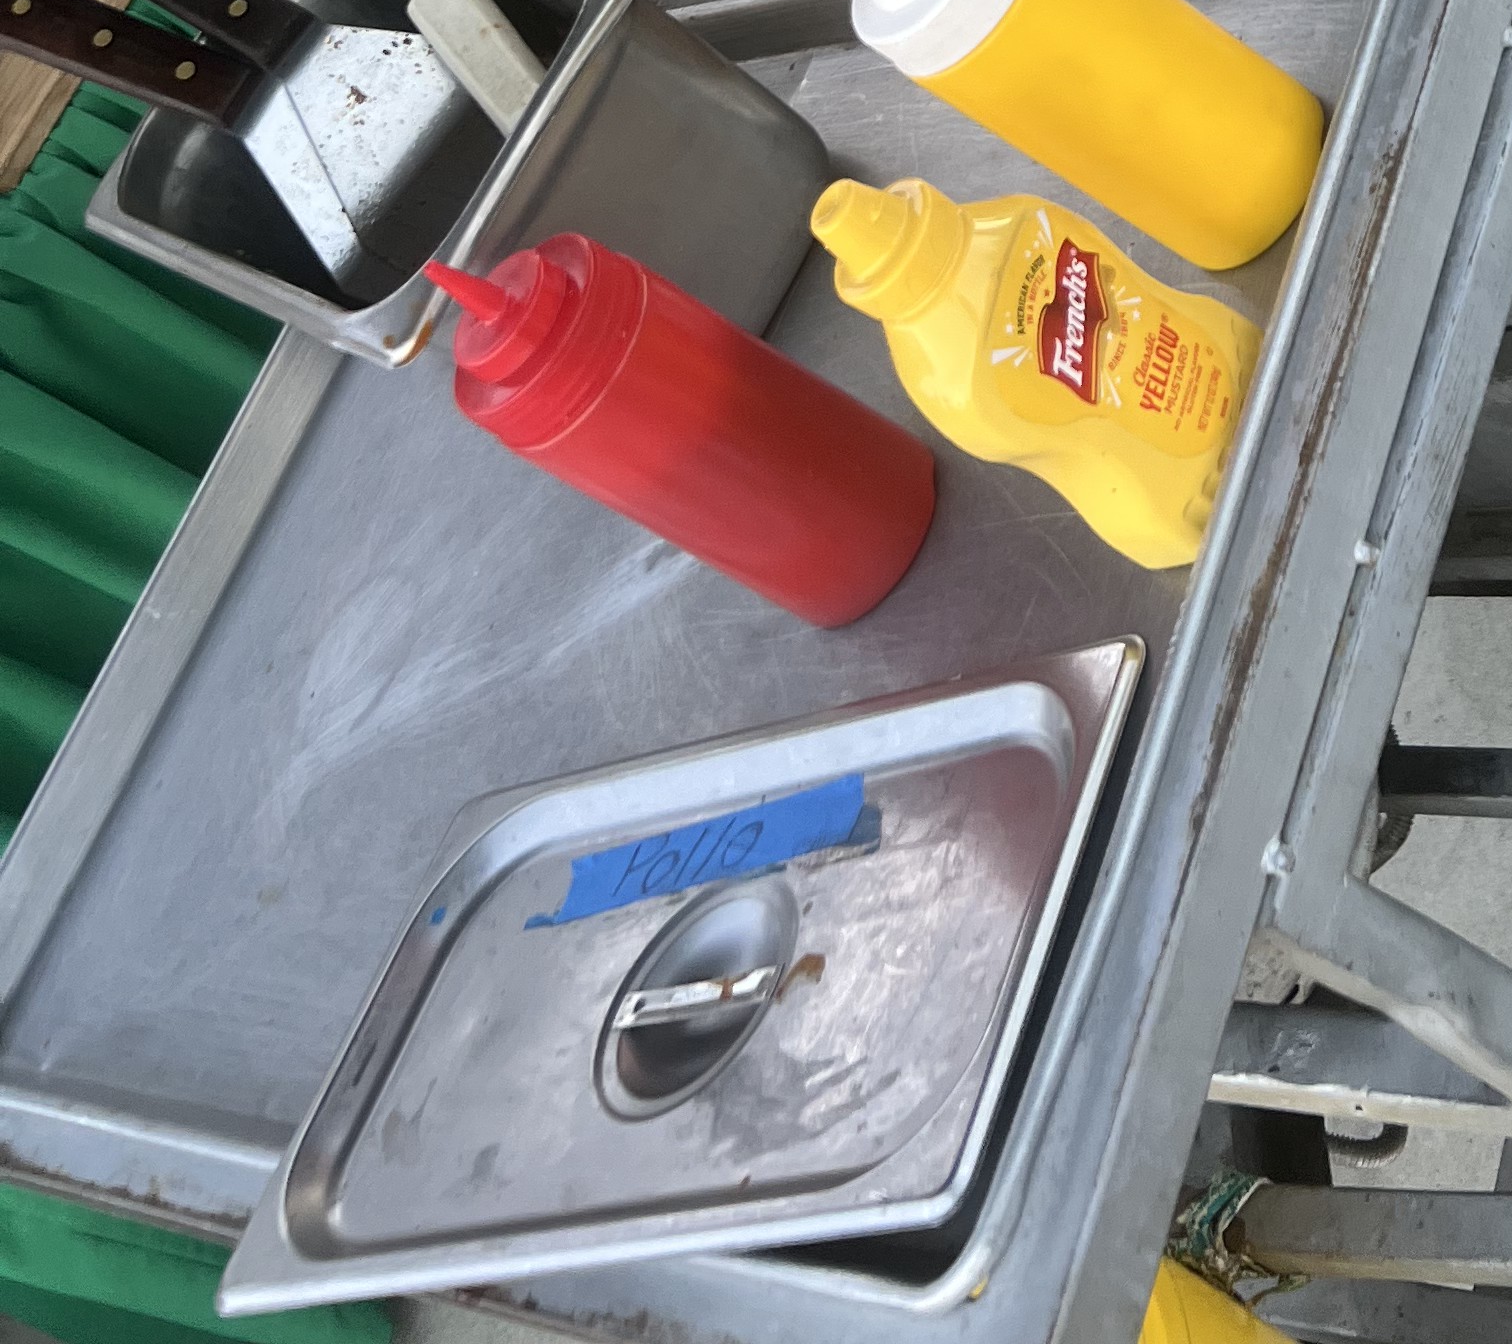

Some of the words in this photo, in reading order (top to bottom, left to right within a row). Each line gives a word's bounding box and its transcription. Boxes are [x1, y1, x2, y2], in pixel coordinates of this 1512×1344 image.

[1053, 257, 1088, 387] French's
[1133, 332, 1157, 387] Classic
[1140, 322, 1180, 413] YELLOW
[1164, 344, 1189, 414] MUSTARD
